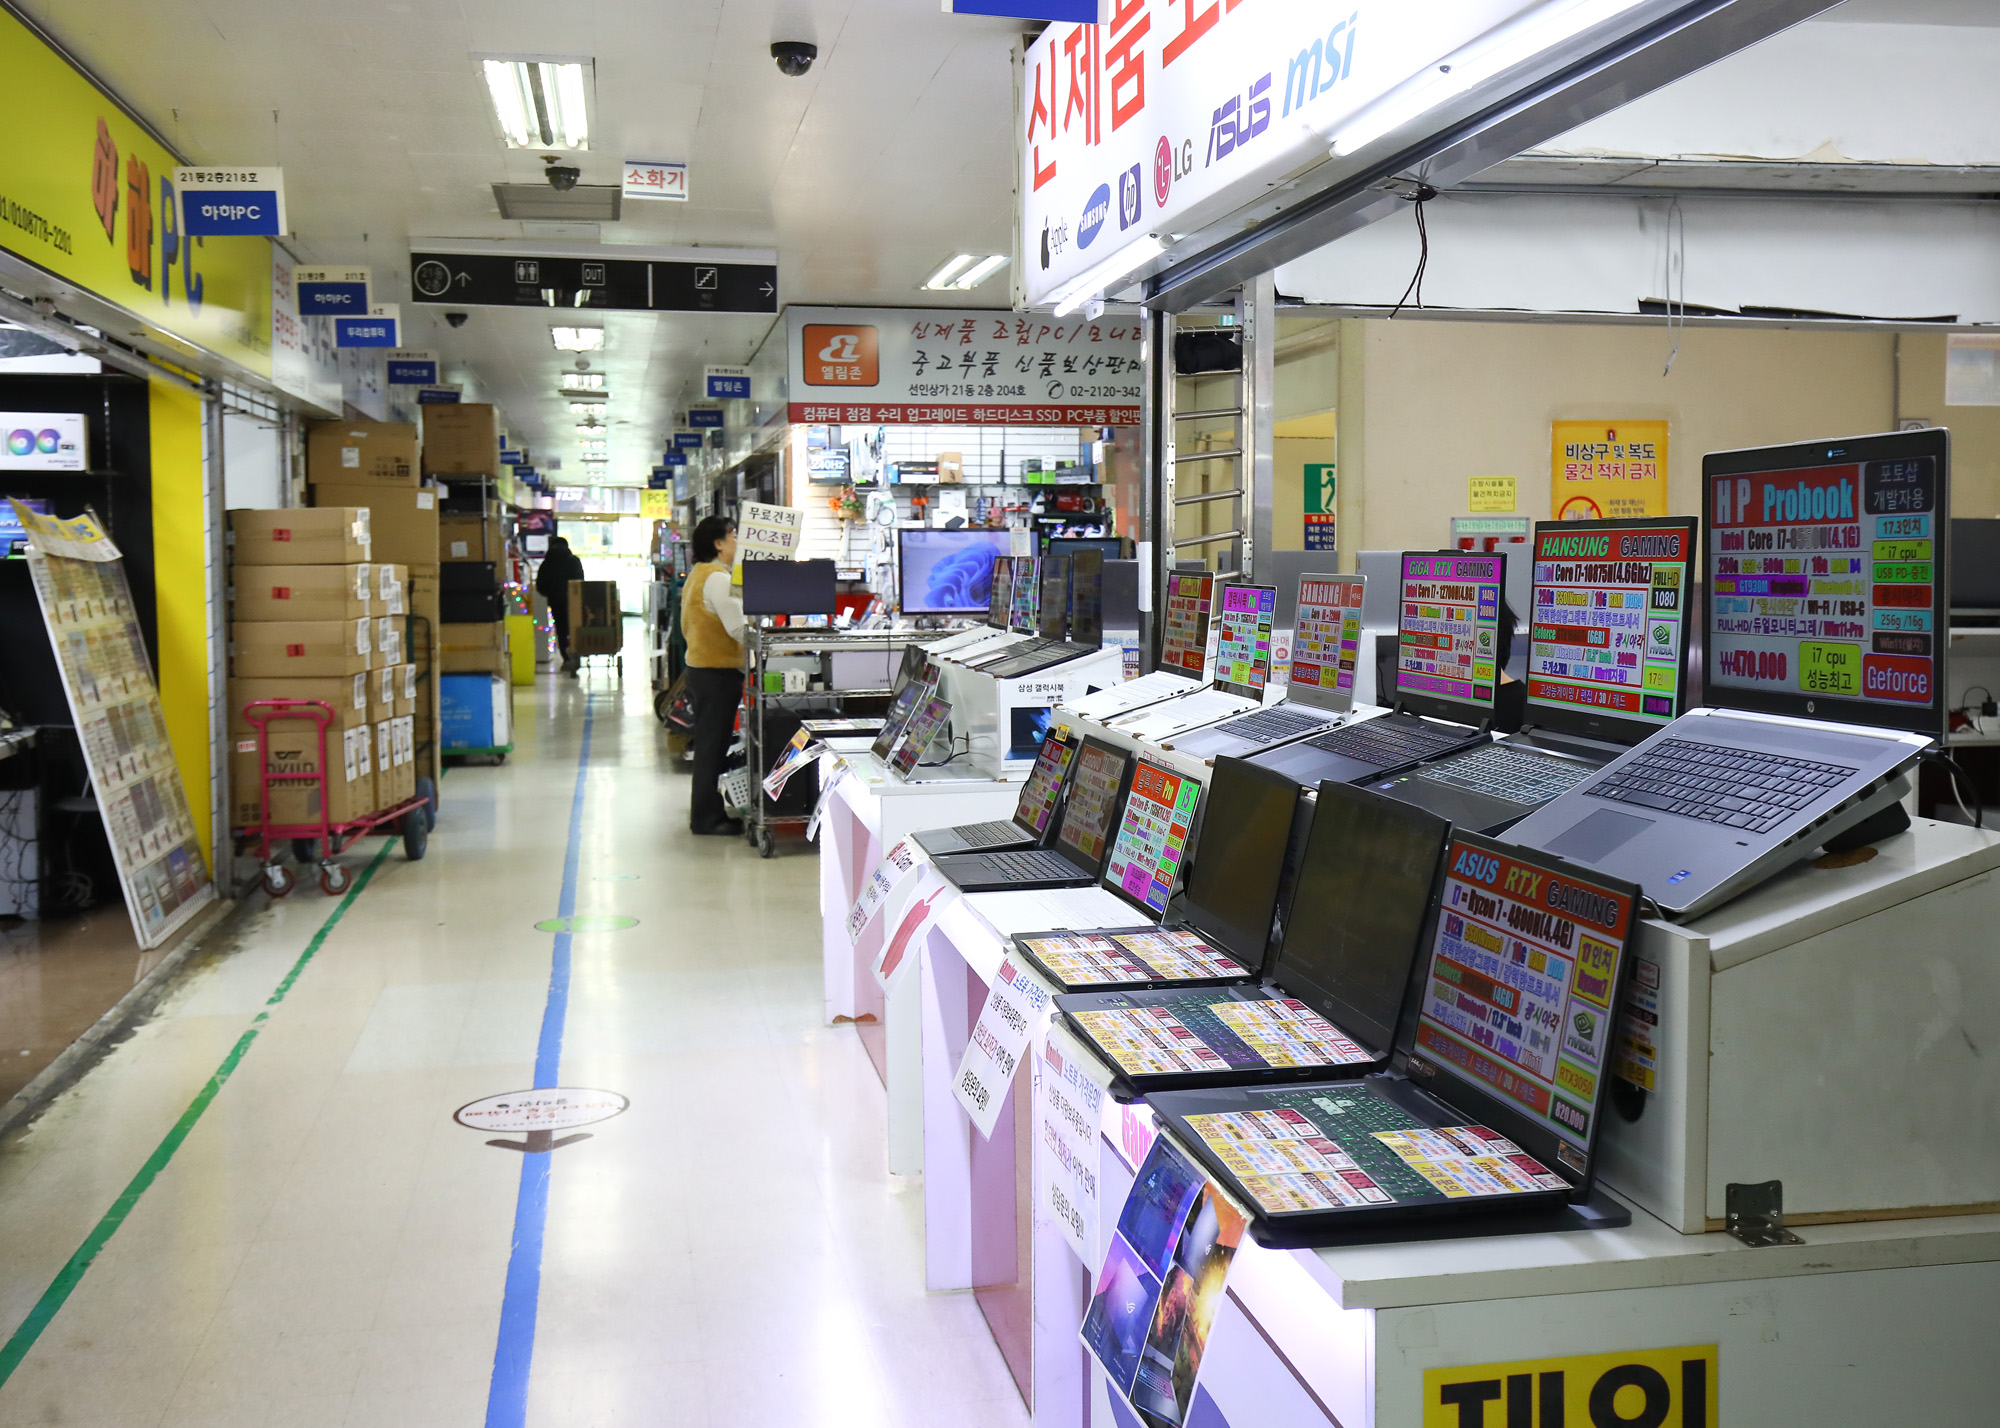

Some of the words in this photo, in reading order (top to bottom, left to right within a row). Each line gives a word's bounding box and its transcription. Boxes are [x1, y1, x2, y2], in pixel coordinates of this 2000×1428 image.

[1282, 11, 1358, 118] msi
[1027, 0, 1150, 192] 신제품
[1205, 71, 1272, 168] ASUS
[1174, 138, 1192, 182] LG
[626, 169, 684, 190] 소화기
[201, 205, 261, 220] 하하PC
[1080, 200, 1107, 233] SAMSUNG
[0, 193, 72, 256] 1/0108778-2201
[1050, 216, 1068, 255] Apple
[585, 268, 602, 280] OUT
[911, 319, 976, 346] 신제품
[821, 366, 863, 380] 엘림존
[911, 351, 1000, 379] 중고부품
[713, 381, 743, 392] 엘림존
[908, 384, 949, 396] 선인상가
[952, 384, 974, 397] 21동
[978, 384, 995, 397] 2층
[996, 384, 1027, 397] 204호
[803, 407, 841, 422] 컴퓨터
[846, 407, 871, 422] 점검
[876, 407, 900, 422] 수리
[907, 407, 968, 422] 업그레이드
[973, 408, 1034, 422] 하드디스크
[1036, 409, 1062, 422] SSD
[1066, 408, 1107, 424] PC부품
[1565, 443, 1610, 461] 비상구
[1613, 445, 1625, 459] 및
[1628, 443, 1656, 460] 복도
[1565, 463, 1593, 480] 물건
[1597, 463, 1626, 480] 적치
[1629, 463, 1657, 480] 금지
[1880, 461, 1918, 483] 포토샵
[1716, 478, 1751, 524] HP
[1763, 477, 1854, 522] Probook
[1873, 488, 1924, 511] 개발자용
[749, 507, 795, 526] 무료견적
[1883, 517, 1921, 535] 17.3인치
[746, 527, 792, 547] PC조립
[1541, 536, 1610, 557] HANSUNG
[1620, 534, 1680, 558] GAMING
[1748, 530, 1773, 550] Core
[1900, 548, 1917, 562] cpu
[1433, 561, 1453, 577] RTX
[1456, 561, 1494, 579] GAMING
[1555, 564, 1574, 582] Core
[1877, 567, 1893, 579] USB
[1302, 583, 1340, 605] SAMSUNG
[1609, 593, 1623, 608] RAM
[1624, 593, 1644, 609] DDR4
[1654, 590, 1675, 607] 1080
[1881, 614, 1902, 629] 256g
[1615, 632, 1645, 650] 광시야각
[1720, 650, 1787, 681] ₩470,000
[1813, 647, 1822, 663] i7
[1826, 652, 1846, 668] cpu
[1018, 684, 1032, 692] 삼성
[1035, 684, 1064, 692] 갤럭시북
[1807, 669, 1852, 691] 성능최고
[1868, 665, 1928, 694] Geforce
[1598, 692, 1607, 704] 3D
[1162, 780, 1175, 801] Pro
[1181, 785, 1193, 808] i5
[1453, 850, 1500, 885] ASUS
[1504, 866, 1544, 900] RTX
[1546, 879, 1619, 929] GAMING
[1003, 1056, 1016, 1079] 판매
[1063, 1060, 1079, 1092] 노트북
[1559, 1066, 1593, 1095] RTX3050
[1072, 1155, 1085, 1181] 이하
[1084, 1165, 1096, 1200] 판매
[1051, 1181, 1070, 1225] 상담문의
